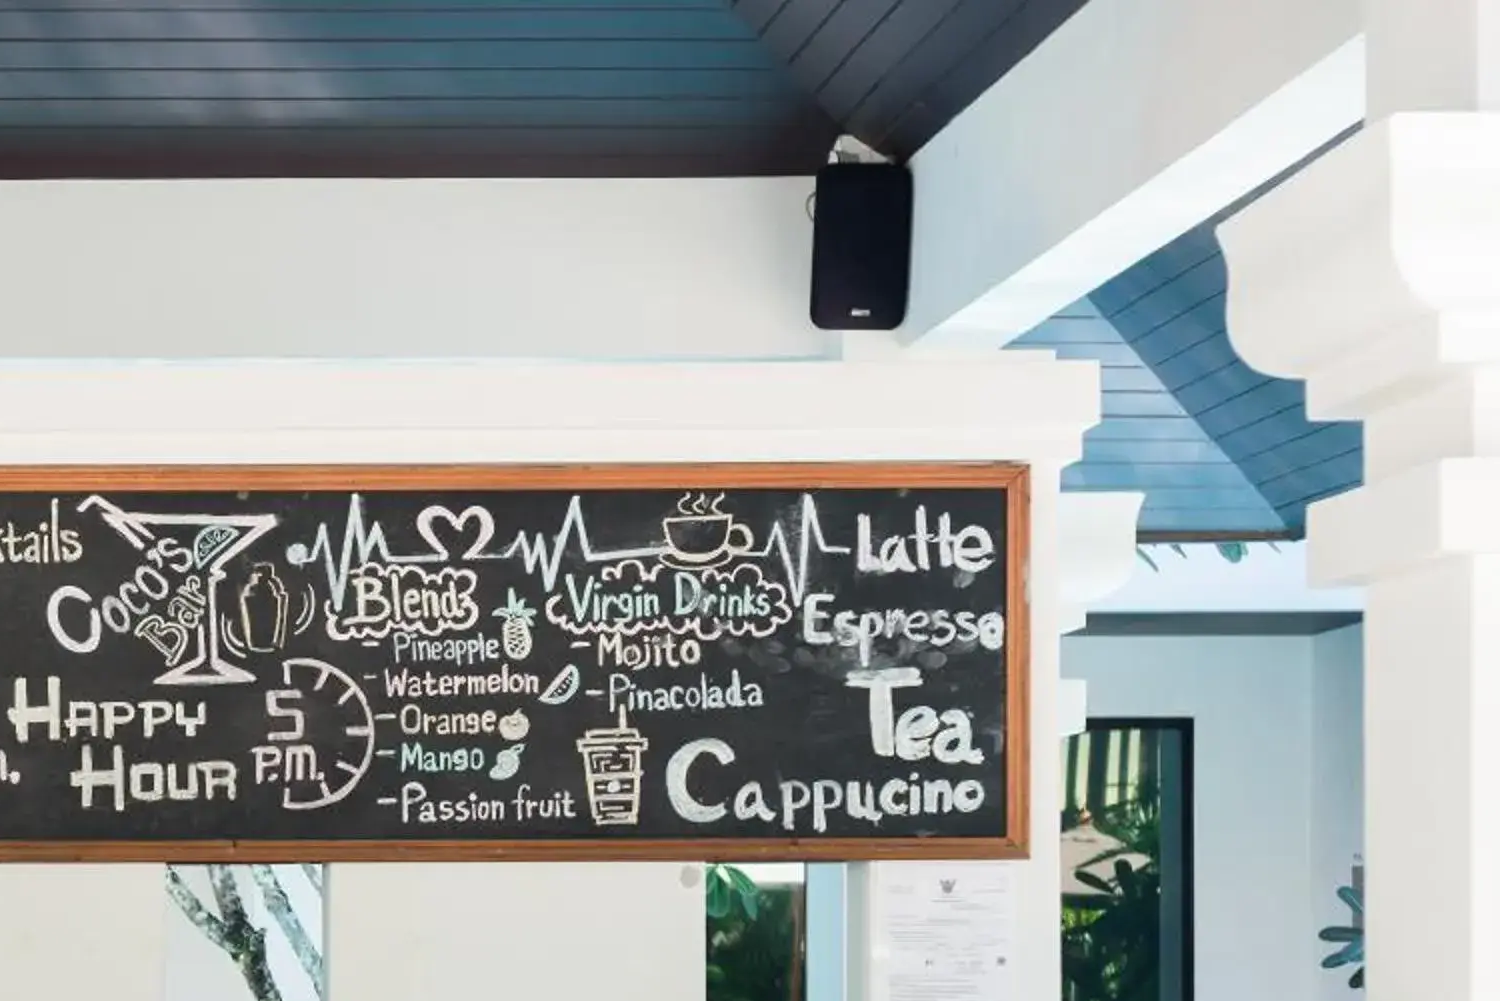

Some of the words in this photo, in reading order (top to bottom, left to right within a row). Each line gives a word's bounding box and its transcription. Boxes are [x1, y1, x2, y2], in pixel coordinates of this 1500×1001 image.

[856, 504, 996, 573] Latte
[47, 537, 194, 653] Coco's
[565, 572, 659, 624] Virgin
[674, 571, 772, 618] Drinks
[393, 631, 501, 666] Pineapple
[597, 631, 701, 671] Mojito
[803, 593, 1005, 667] Espresso
[385, 665, 540, 699] Watermelon
[608, 668, 764, 713] Pinacolada
[265, 689, 305, 742] 5
[400, 703, 497, 736] Orange
[845, 666, 985, 765] Tea
[400, 741, 486, 773] Mango
[401, 780, 504, 823] Passion
[511, 783, 577, 822] fruit
[665, 737, 985, 833] Cappucino
